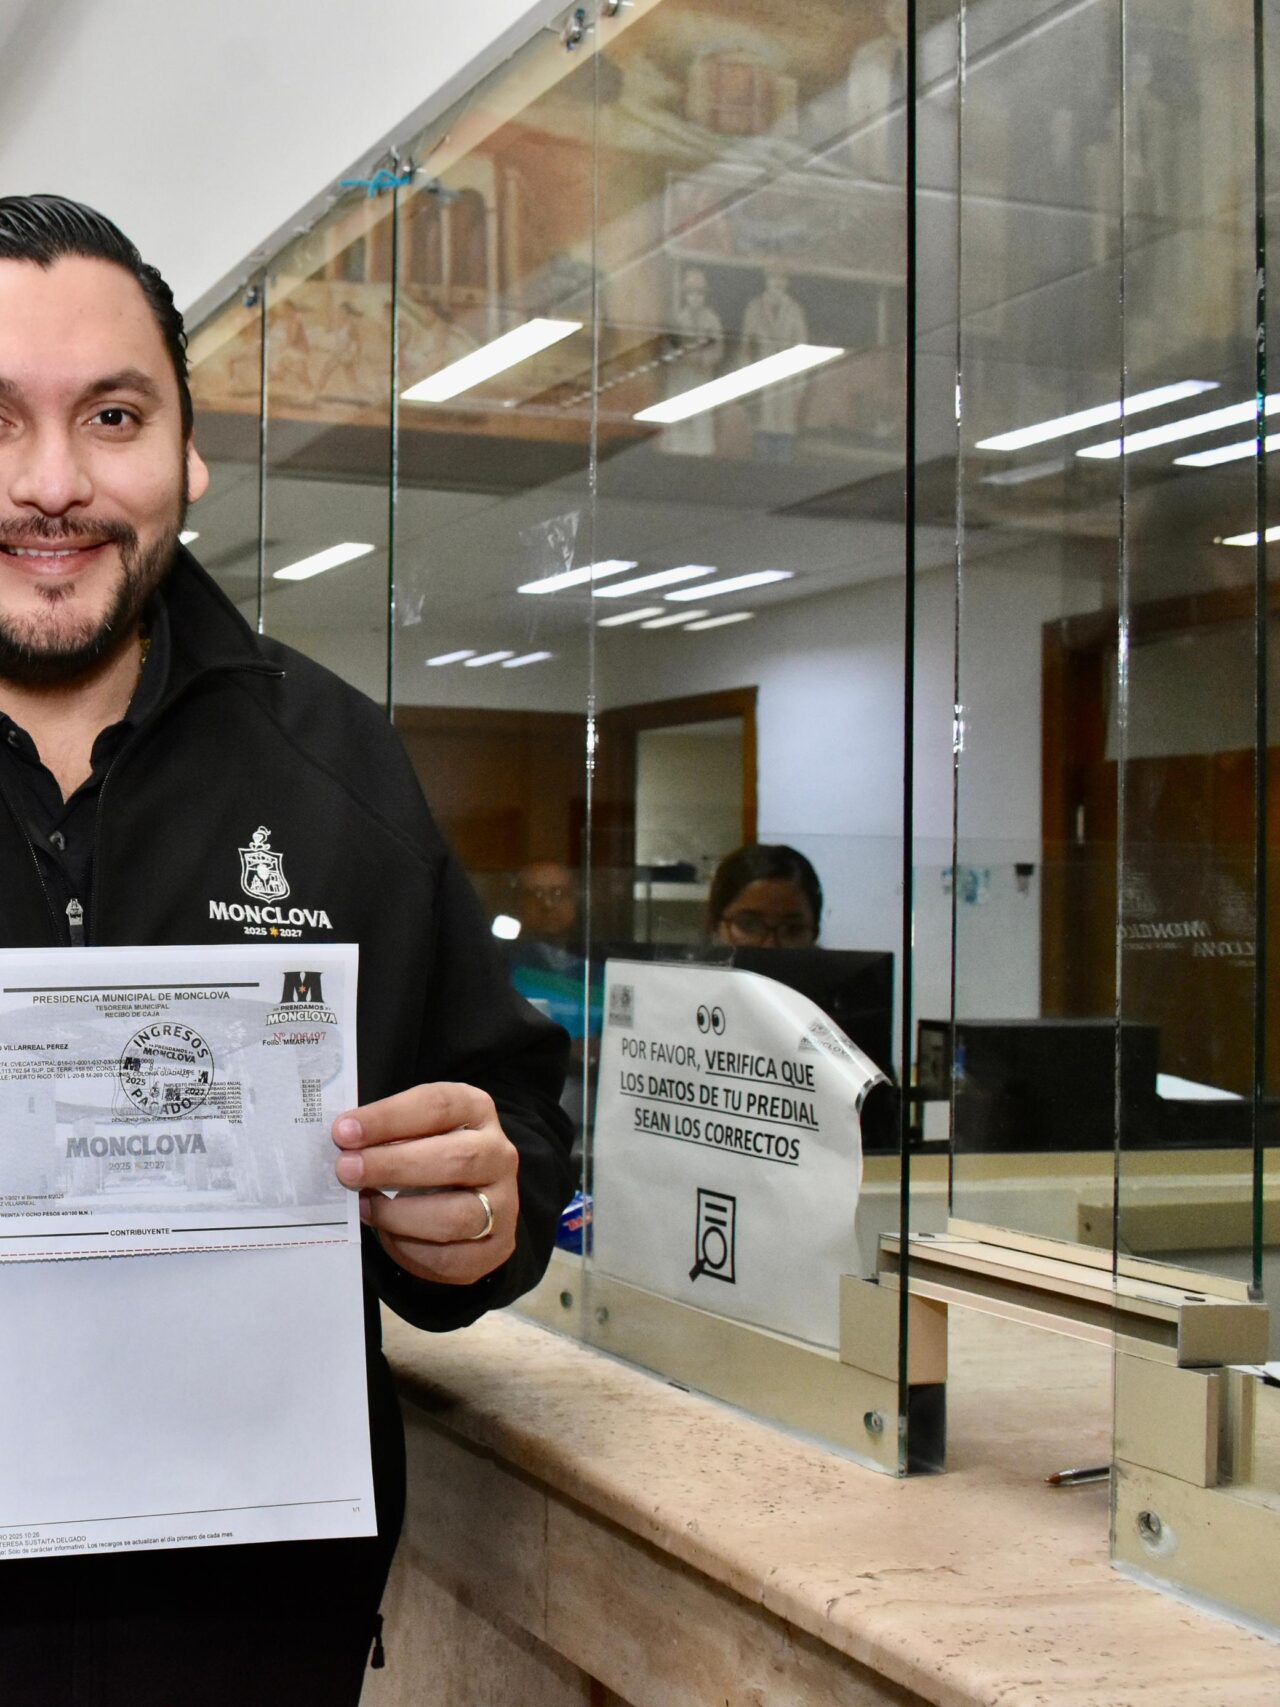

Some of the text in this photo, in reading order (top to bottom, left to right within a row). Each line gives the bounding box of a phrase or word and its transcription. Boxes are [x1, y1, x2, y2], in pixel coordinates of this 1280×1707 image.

[209, 900, 333, 929] MONCLOVA
[244, 926, 302, 937] 2025 2027
[33, 991, 230, 1004] PRESIDENCIA MUNICIPAL DE MONCLOVA
[266, 1011, 338, 1026] MONCLOVA
[133, 1025, 208, 1058] INGRESOS
[143, 1047, 196, 1064] MONCLOVA
[622, 1038, 815, 1087] POR FAVOR, VERIFICA QUE
[126, 1077, 146, 1086] 2025
[620, 1071, 819, 1126] LOS DATOS DE TU PREDIAL
[634, 1108, 800, 1160] SEAN LOS CORRECTOS
[66, 1133, 207, 1158] MONCLOVA
[110, 1228, 170, 1236] CONTRIBUYENTE
[0, 1540, 24, 1548] TERESA
[24, 1538, 55, 1546] SUSTAITA
[56, 1535, 87, 1543] DELGADO
